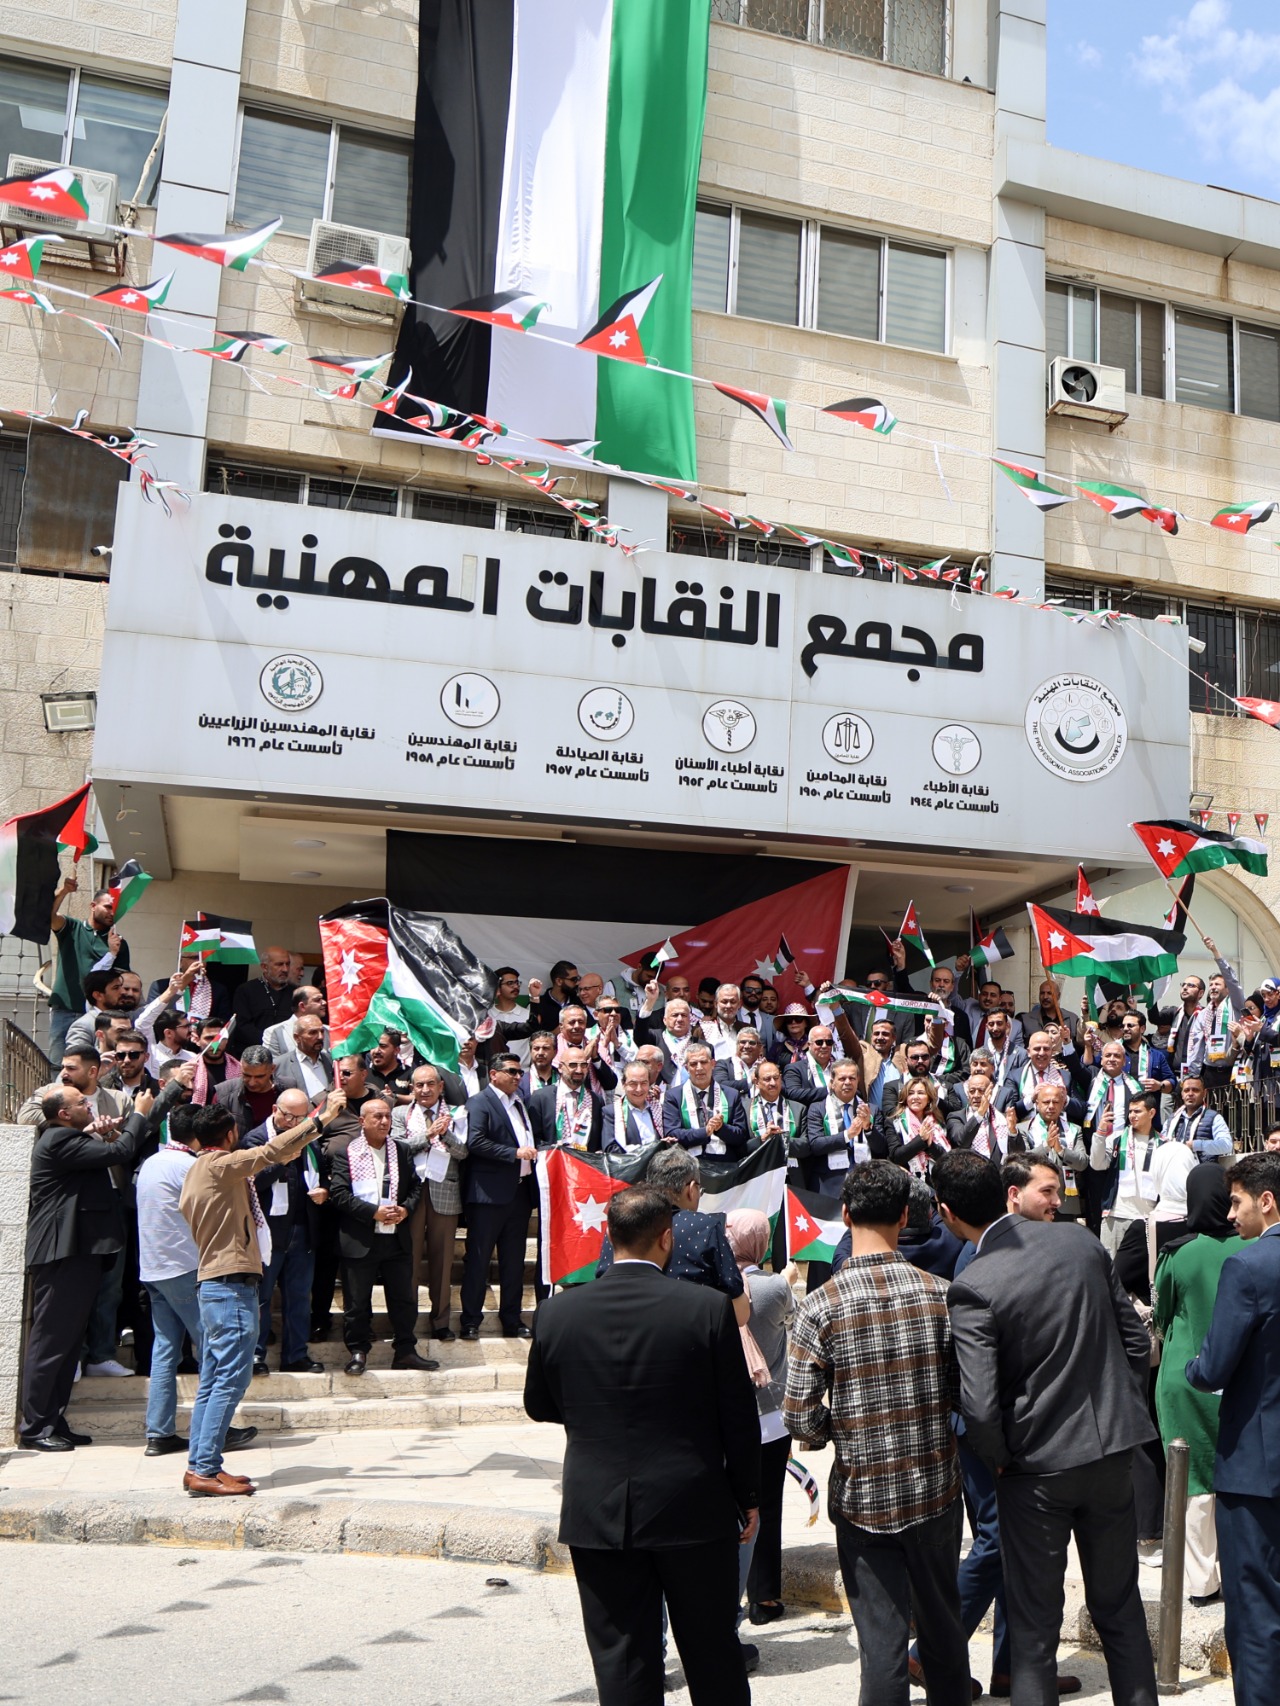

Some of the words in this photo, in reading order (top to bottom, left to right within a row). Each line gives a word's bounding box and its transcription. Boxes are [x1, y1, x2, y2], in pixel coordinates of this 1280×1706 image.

[205, 523, 501, 616] المهنية
[525, 569, 781, 648] النقابات
[800, 613, 985, 682] مجمع
[1034, 681, 1061, 703] المهنية
[1063, 678, 1102, 692] النقابات
[1100, 691, 1121, 717] مجمع
[198, 713, 258, 730] الزراعيين
[260, 718, 337, 737] المهندسين
[340, 725, 376, 740] نقابة
[227, 735, 256, 748] ١٩٦٦
[258, 738, 285, 752] عام
[287, 739, 343, 756] تأسست
[407, 732, 481, 750] المهندسين
[483, 739, 518, 754] نقابة
[405, 750, 434, 763] ١٩٥٨
[436, 753, 461, 767] عام
[555, 746, 609, 762] الصيادلة
[611, 750, 644, 765] نقابة
[1034, 737, 1067, 773] PROFESSIONAL
[1068, 765, 1108, 776] ASSOCIATIONS
[1108, 735, 1123, 764] COMPLEX
[463, 755, 515, 770] تأسست
[545, 763, 572, 776] ١٩٥٧
[675, 757, 719, 771] الأسنان
[720, 761, 752, 775] أطباء
[574, 765, 597, 779] عام
[600, 767, 650, 782] تأسست
[754, 764, 785, 778] نقابة
[806, 769, 855, 784] المحامين
[678, 775, 704, 787] ١٩٥٢
[706, 777, 728, 791] عام
[730, 779, 778, 793] تأسست
[858, 774, 887, 788] نقابة
[923, 780, 959, 794] الأطباء
[823, 788, 844, 801] عام
[846, 790, 891, 804] تأسست
[961, 784, 989, 797] نقابة
[910, 796, 932, 808] ١٩٤٤
[934, 798, 954, 811] عام
[956, 799, 999, 813] تأسست
[900, 1000, 929, 1009] JORDAN
